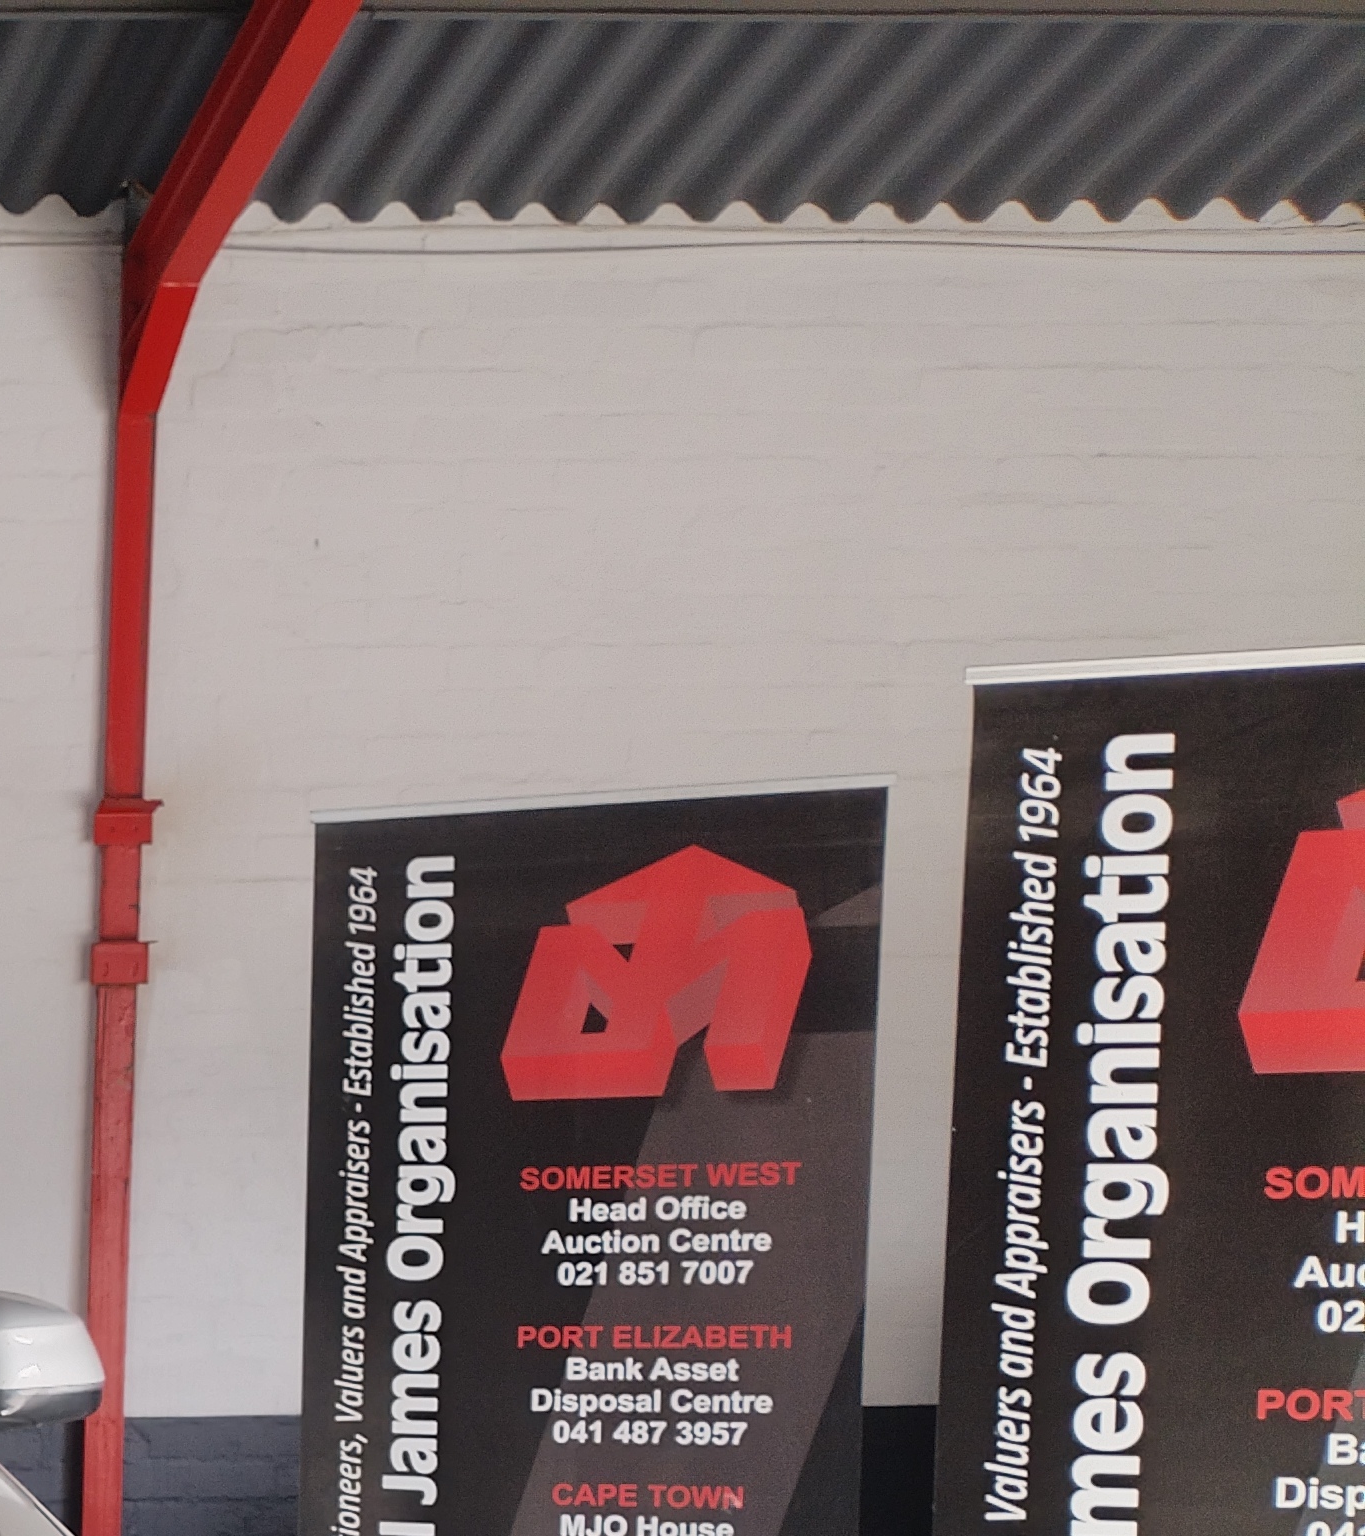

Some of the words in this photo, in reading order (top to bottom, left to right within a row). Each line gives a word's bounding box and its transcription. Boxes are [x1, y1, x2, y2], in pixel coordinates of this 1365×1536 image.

[1018, 747, 1063, 842] 1964
[347, 866, 378, 935] 1964
[1005, 850, 1057, 1068] Established
[342, 940, 376, 1097] Established
[1066, 732, 1176, 1326] Organisation
[385, 855, 456, 1282] Organisation
[337, 1119, 375, 1263] Appraisers
[520, 1163, 698, 1191] SOMERSET
[706, 1161, 801, 1187] WEST
[569, 1196, 648, 1223] Head
[654, 1195, 747, 1221] Office
[994, 1099, 1050, 1300] Appraisers
[541, 1228, 661, 1255] Auction
[668, 1227, 773, 1253] Centre
[557, 1260, 608, 1287] 021
[618, 1260, 670, 1286] 851
[680, 1259, 754, 1285] 7007
[335, 1265, 367, 1320] and
[1317, 1300, 1365, 1333] 02
[517, 1325, 604, 1349] PORT
[612, 1324, 792, 1349] ELIZABETH
[565, 1356, 644, 1382] Bank
[648, 1356, 740, 1382] Asset
[990, 1302, 1036, 1379] and
[333, 1325, 365, 1422] Valuers
[381, 1299, 442, 1506] James
[530, 1388, 662, 1418] Disposal
[669, 1388, 774, 1414] Centre
[552, 1419, 602, 1444] 041
[612, 1420, 668, 1445] 487
[675, 1420, 748, 1446] 3957
[983, 1388, 1032, 1521] Valuers
[551, 1482, 638, 1508] CAPE
[647, 1484, 745, 1509] TOWN
